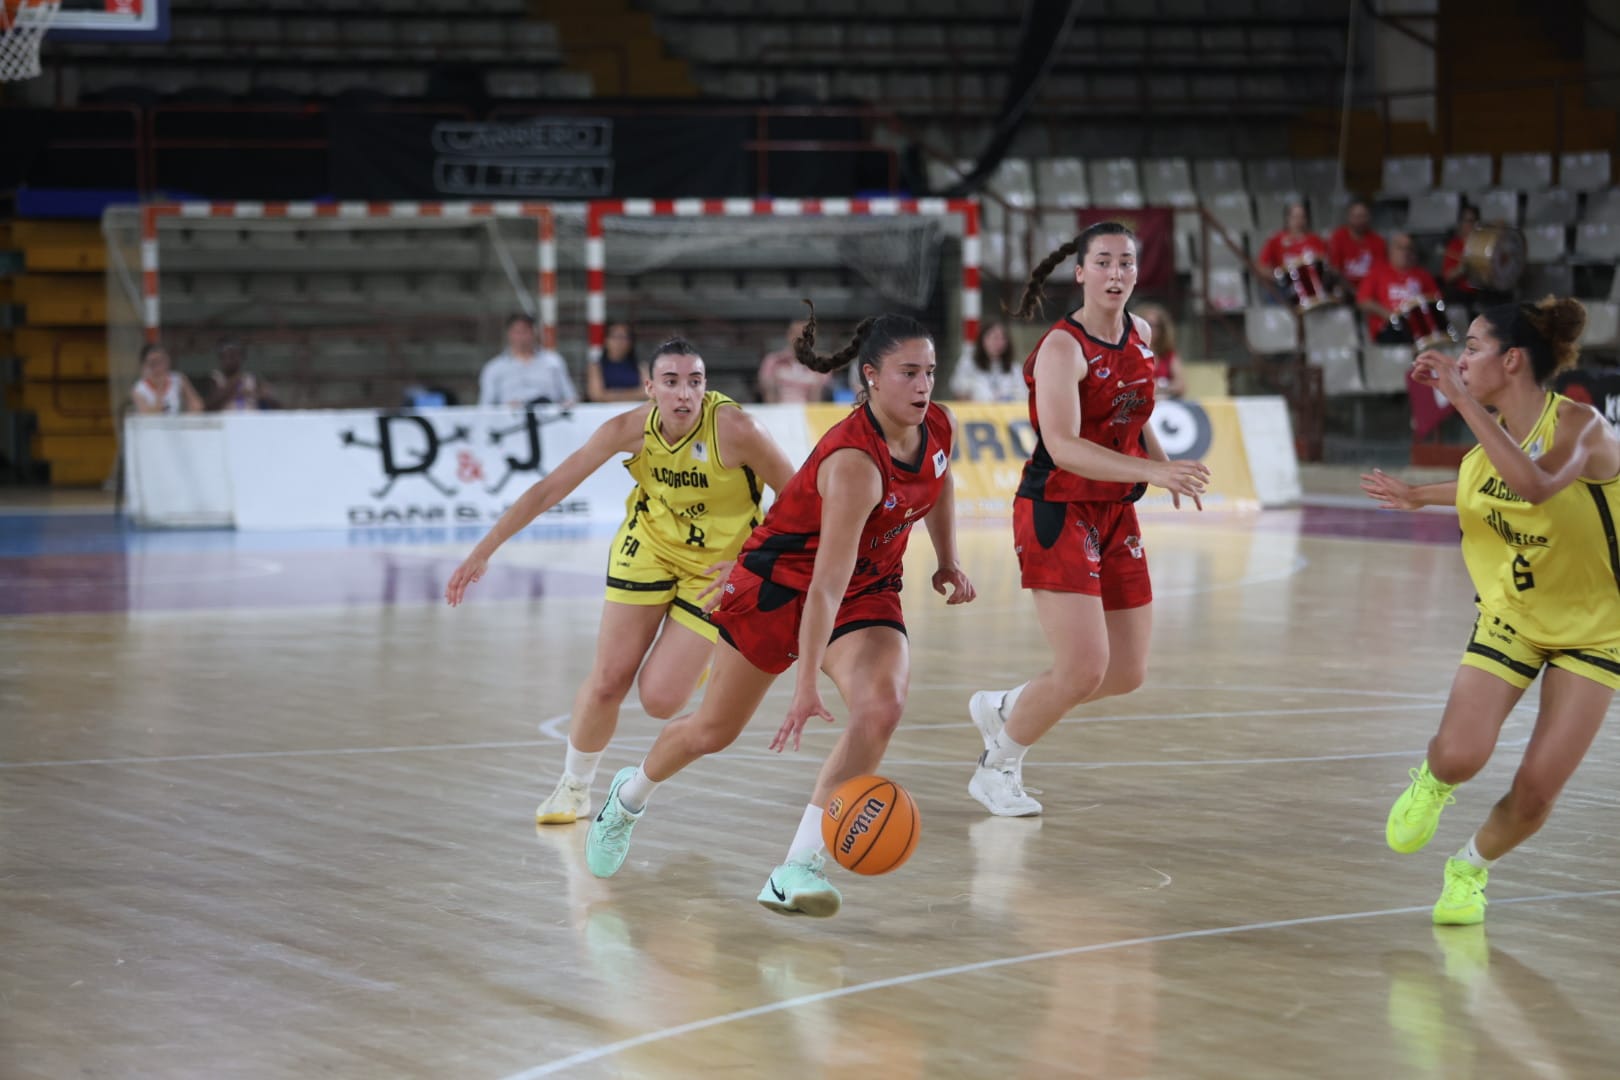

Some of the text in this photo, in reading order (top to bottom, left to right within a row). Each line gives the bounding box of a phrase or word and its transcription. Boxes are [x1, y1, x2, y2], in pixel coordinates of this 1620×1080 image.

[456, 450, 483, 484] &
[650, 466, 709, 488] LCORCÓN
[1512, 553, 1535, 592] 6
[840, 798, 885, 854] Wilson
